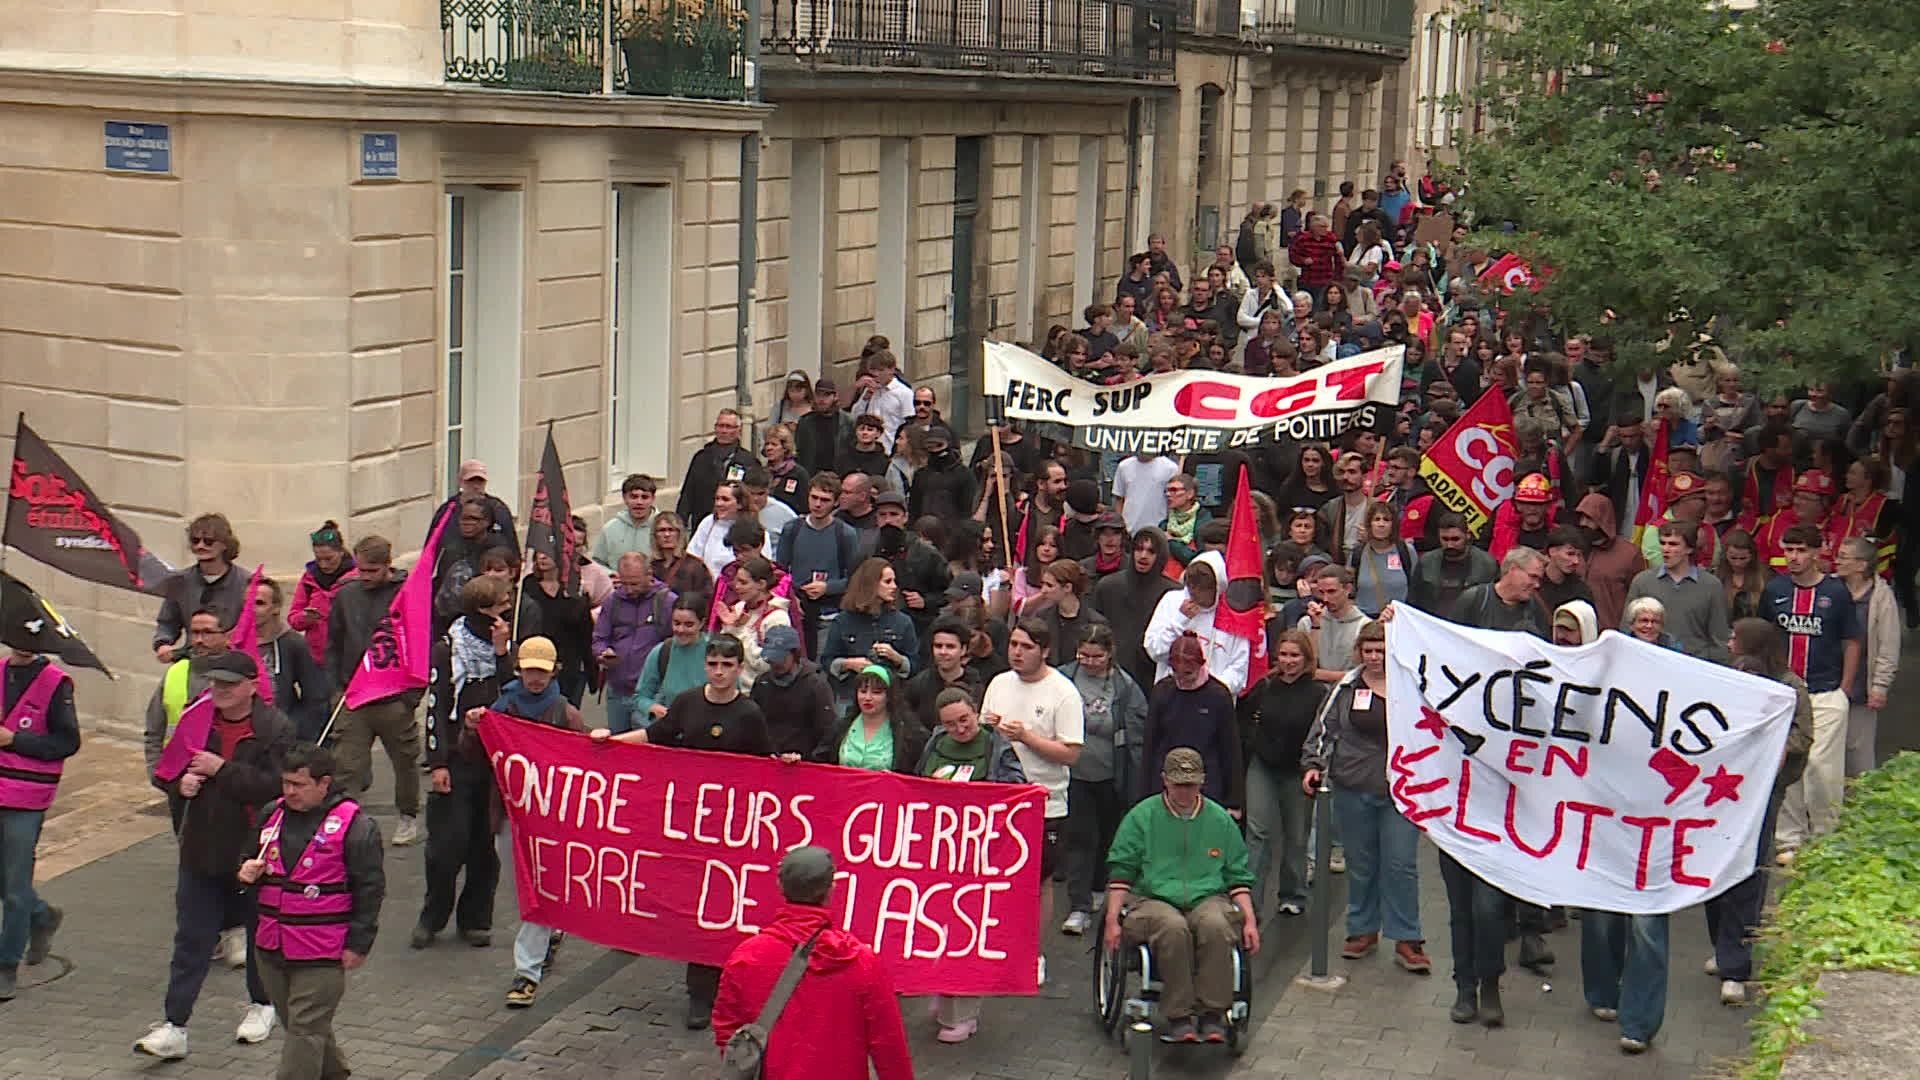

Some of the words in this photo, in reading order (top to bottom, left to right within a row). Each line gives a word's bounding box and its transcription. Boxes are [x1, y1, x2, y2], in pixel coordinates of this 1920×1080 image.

[1004, 379, 1072, 416] FERC
[1093, 382, 1151, 416] SUP
[1174, 361, 1385, 420] CGT
[1085, 426, 1221, 453] UNIVERSITE
[1229, 426, 1264, 447] DE
[1273, 406, 1377, 441] POITIERS
[1426, 471, 1481, 524] ADAPEI
[1777, 612, 1823, 629] QATAR
[1505, 738, 1589, 778] EN
[663, 780, 816, 852] LEURS
[842, 800, 1033, 877] GUERRES
[1454, 759, 1719, 891] LUTTE
[697, 858, 771, 934] DE
